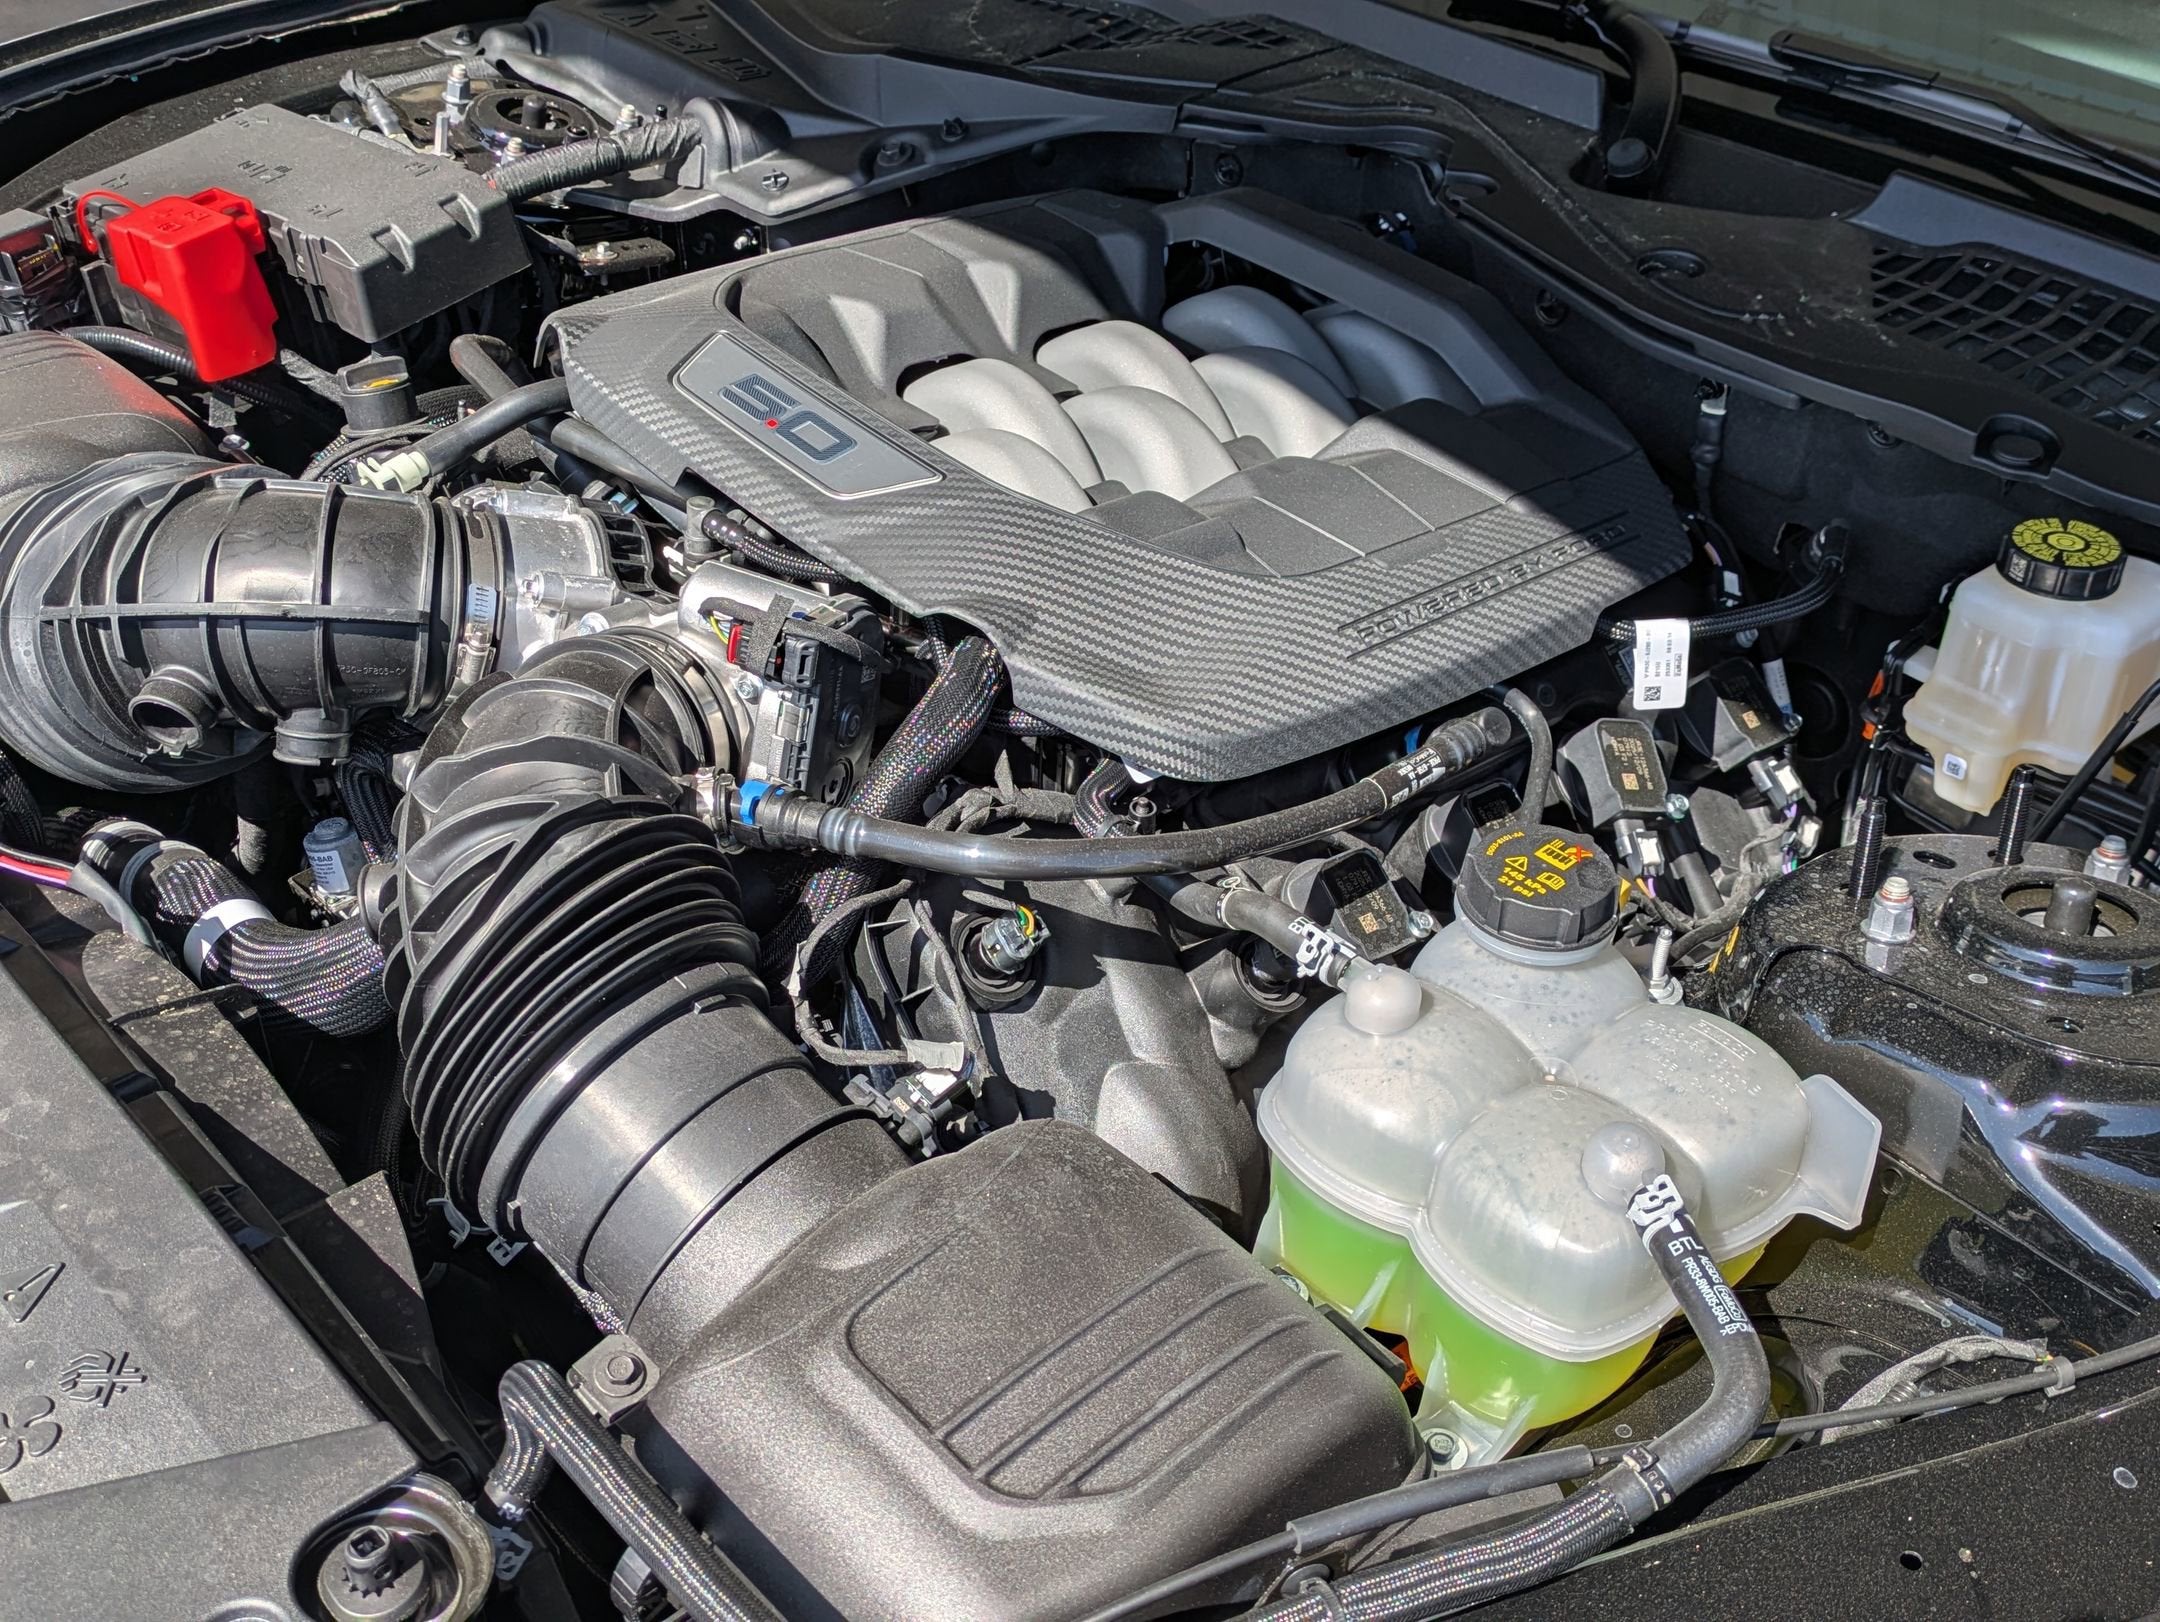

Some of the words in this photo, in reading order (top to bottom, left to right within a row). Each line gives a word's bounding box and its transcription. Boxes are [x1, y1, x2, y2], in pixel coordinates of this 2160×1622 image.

[719, 373, 859, 465] 5.0
[1357, 575, 1504, 647] POWERED
[1509, 555, 1544, 579] BY
[1552, 525, 1626, 561] FORD
[1498, 876, 1515, 887] 21
[1513, 885, 1535, 898] psi
[1504, 866, 1525, 881] 145
[1524, 878, 1547, 895] kPa
[1668, 1236, 1703, 1256] BTL
